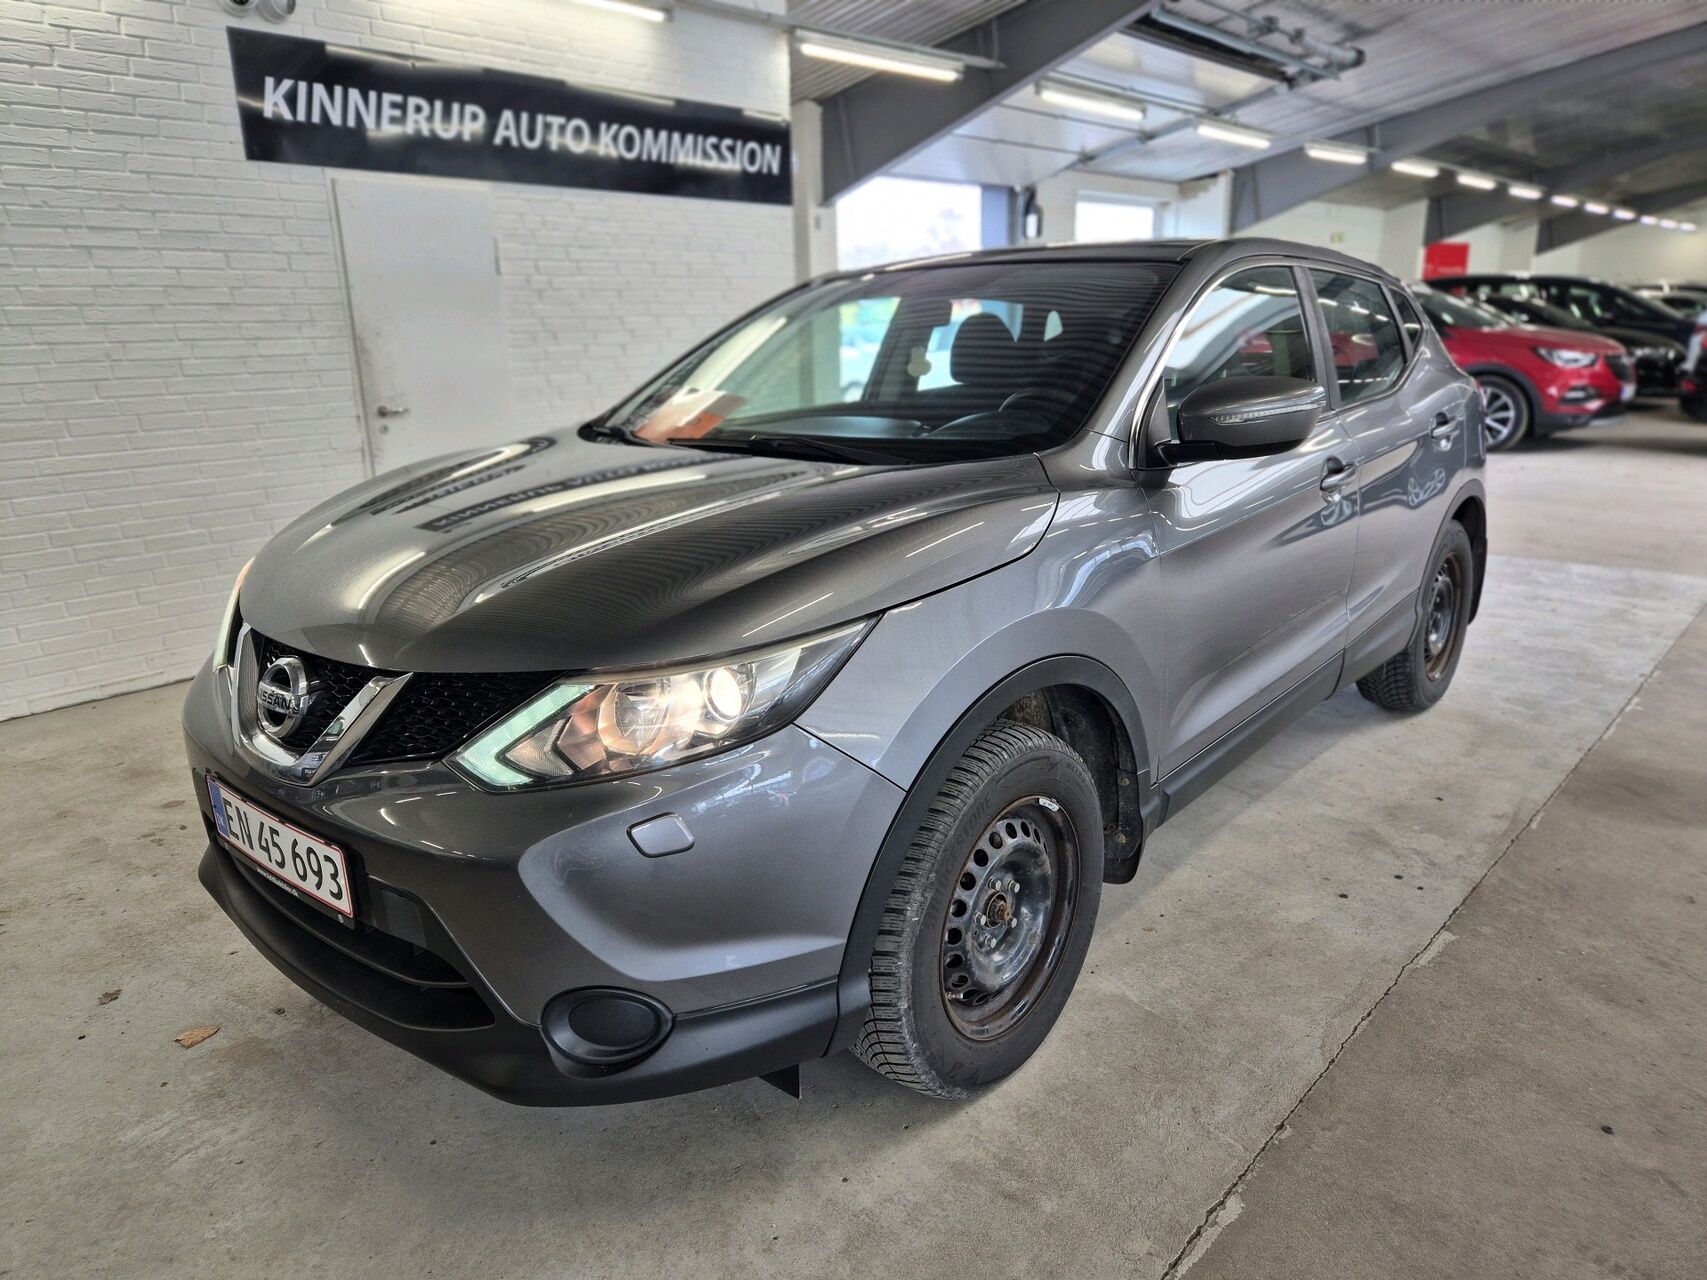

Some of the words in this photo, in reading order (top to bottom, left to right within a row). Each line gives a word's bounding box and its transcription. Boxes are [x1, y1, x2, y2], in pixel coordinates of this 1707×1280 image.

[262, 75, 484, 143] KINNERUP
[493, 109, 590, 156] AUTO
[598, 123, 781, 176] KOMMISSION
[259, 687, 292, 710] ISSAN
[222, 797, 254, 851] EN
[257, 820, 286, 870] 45
[291, 838, 343, 901] 693
